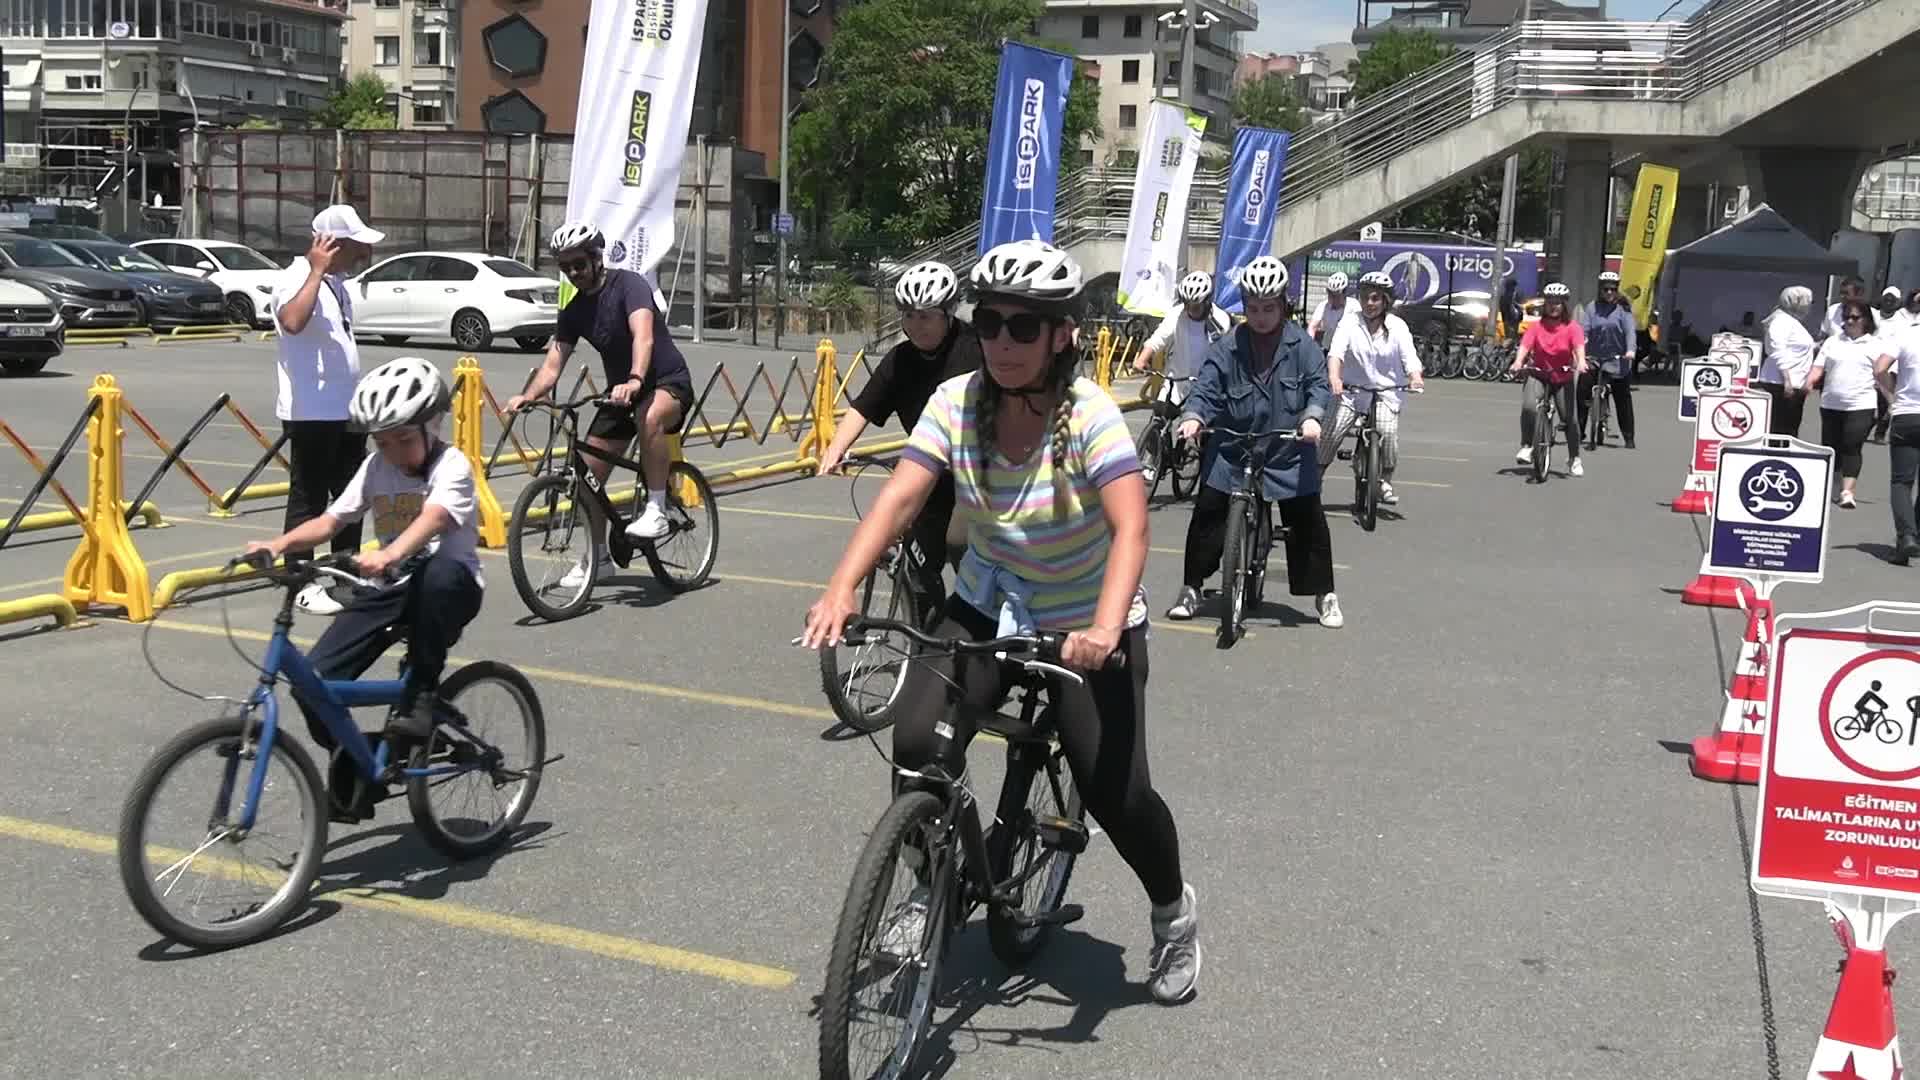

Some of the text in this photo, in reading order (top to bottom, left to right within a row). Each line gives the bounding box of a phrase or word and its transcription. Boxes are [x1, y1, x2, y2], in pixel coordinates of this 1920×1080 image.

[1845, 794, 1918, 813] EĞİTMEN
[1774, 806, 1920, 832] TALİMATLARINA U
